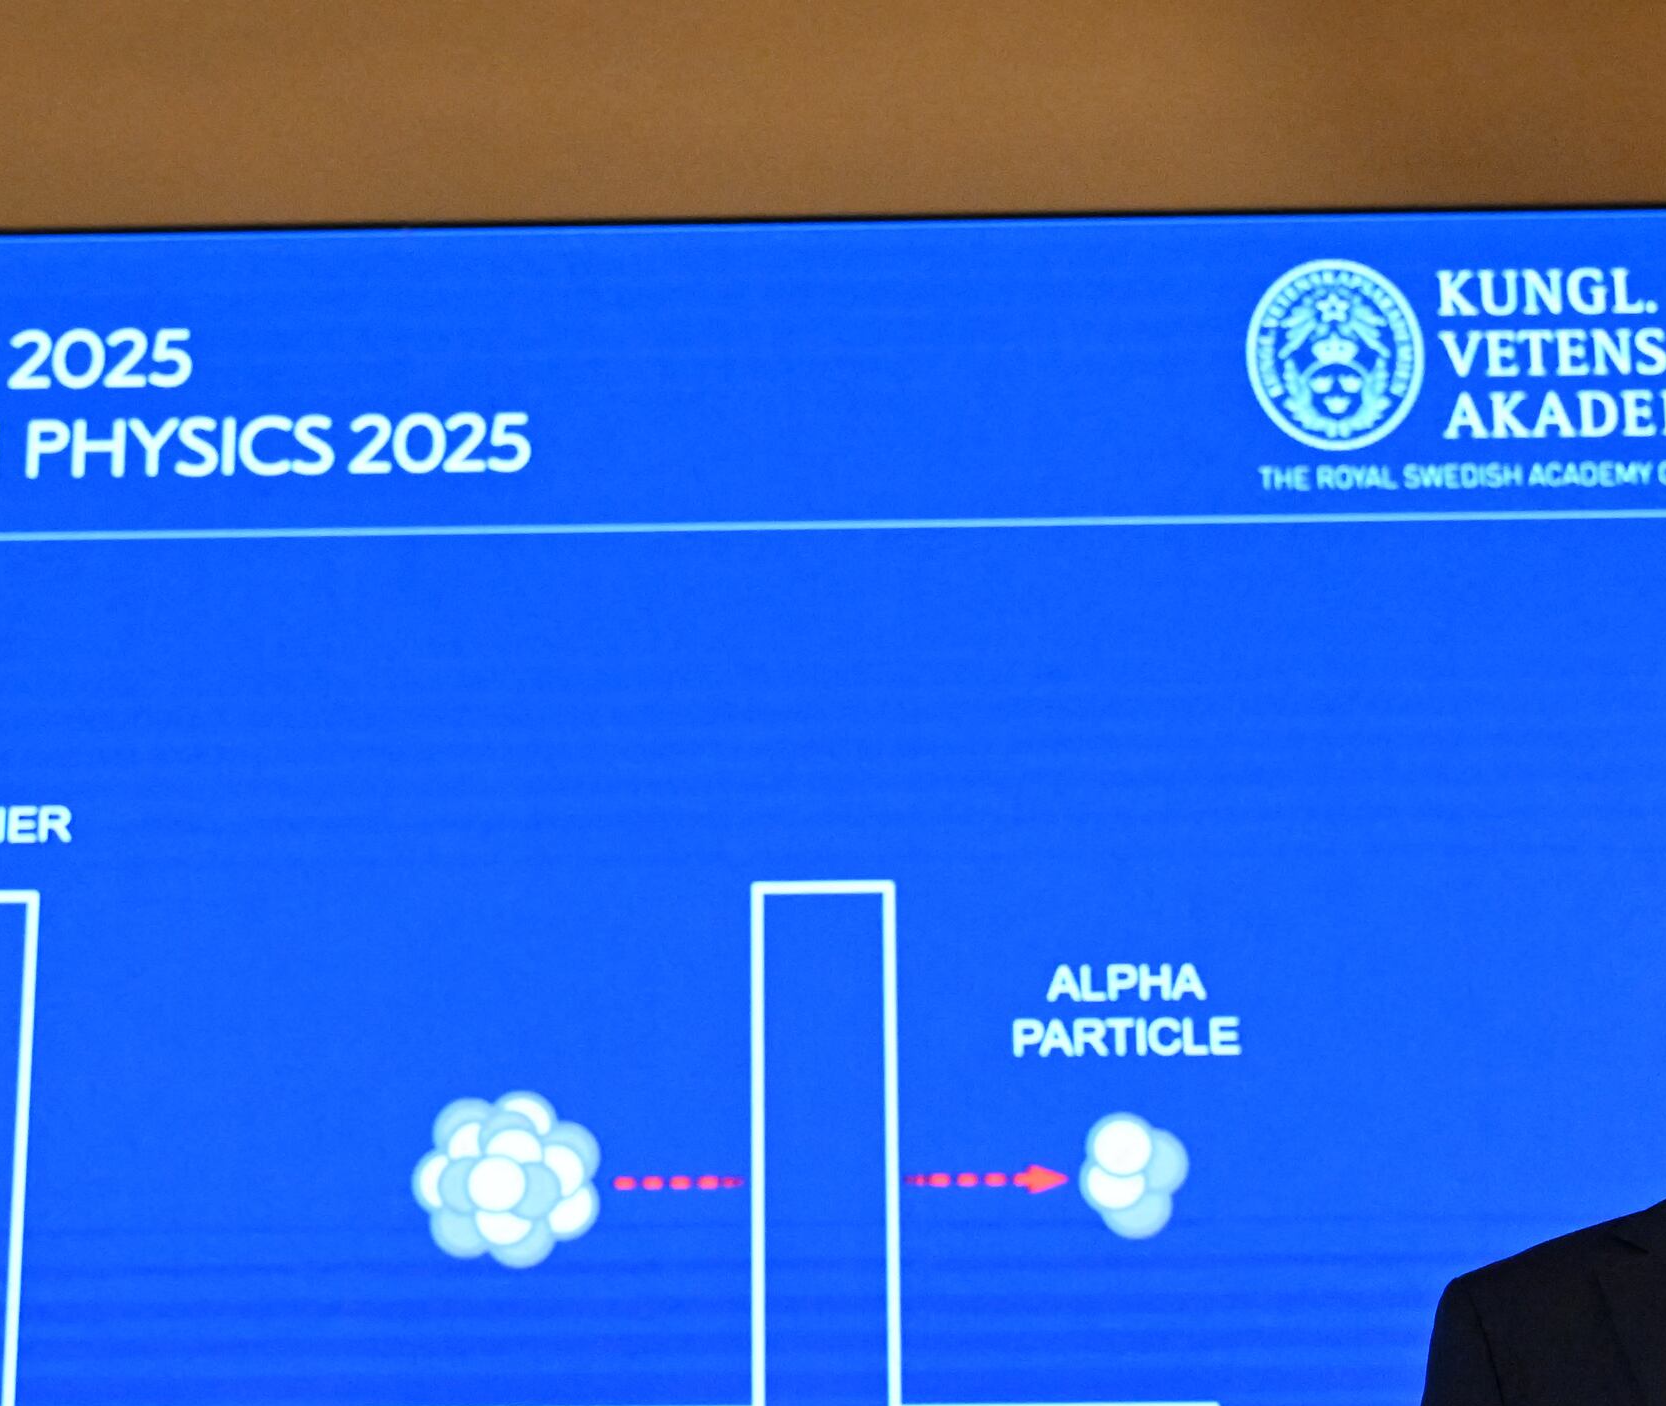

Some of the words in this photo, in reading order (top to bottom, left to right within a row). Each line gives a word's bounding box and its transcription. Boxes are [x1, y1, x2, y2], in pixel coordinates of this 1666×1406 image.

[1437, 266, 1658, 317] KUNGL.
[7, 326, 193, 391] 2025
[25, 413, 335, 480] PHYSICS
[348, 411, 532, 475] 2025
[1258, 464, 1309, 492] THE
[1316, 463, 1398, 491] ROYAL
[1403, 462, 1523, 490] SWEDISH
[1528, 460, 1651, 487] ACADEMY
[1046, 963, 1207, 1002] ALPHA
[1012, 1016, 1242, 1057] PARTICLE
